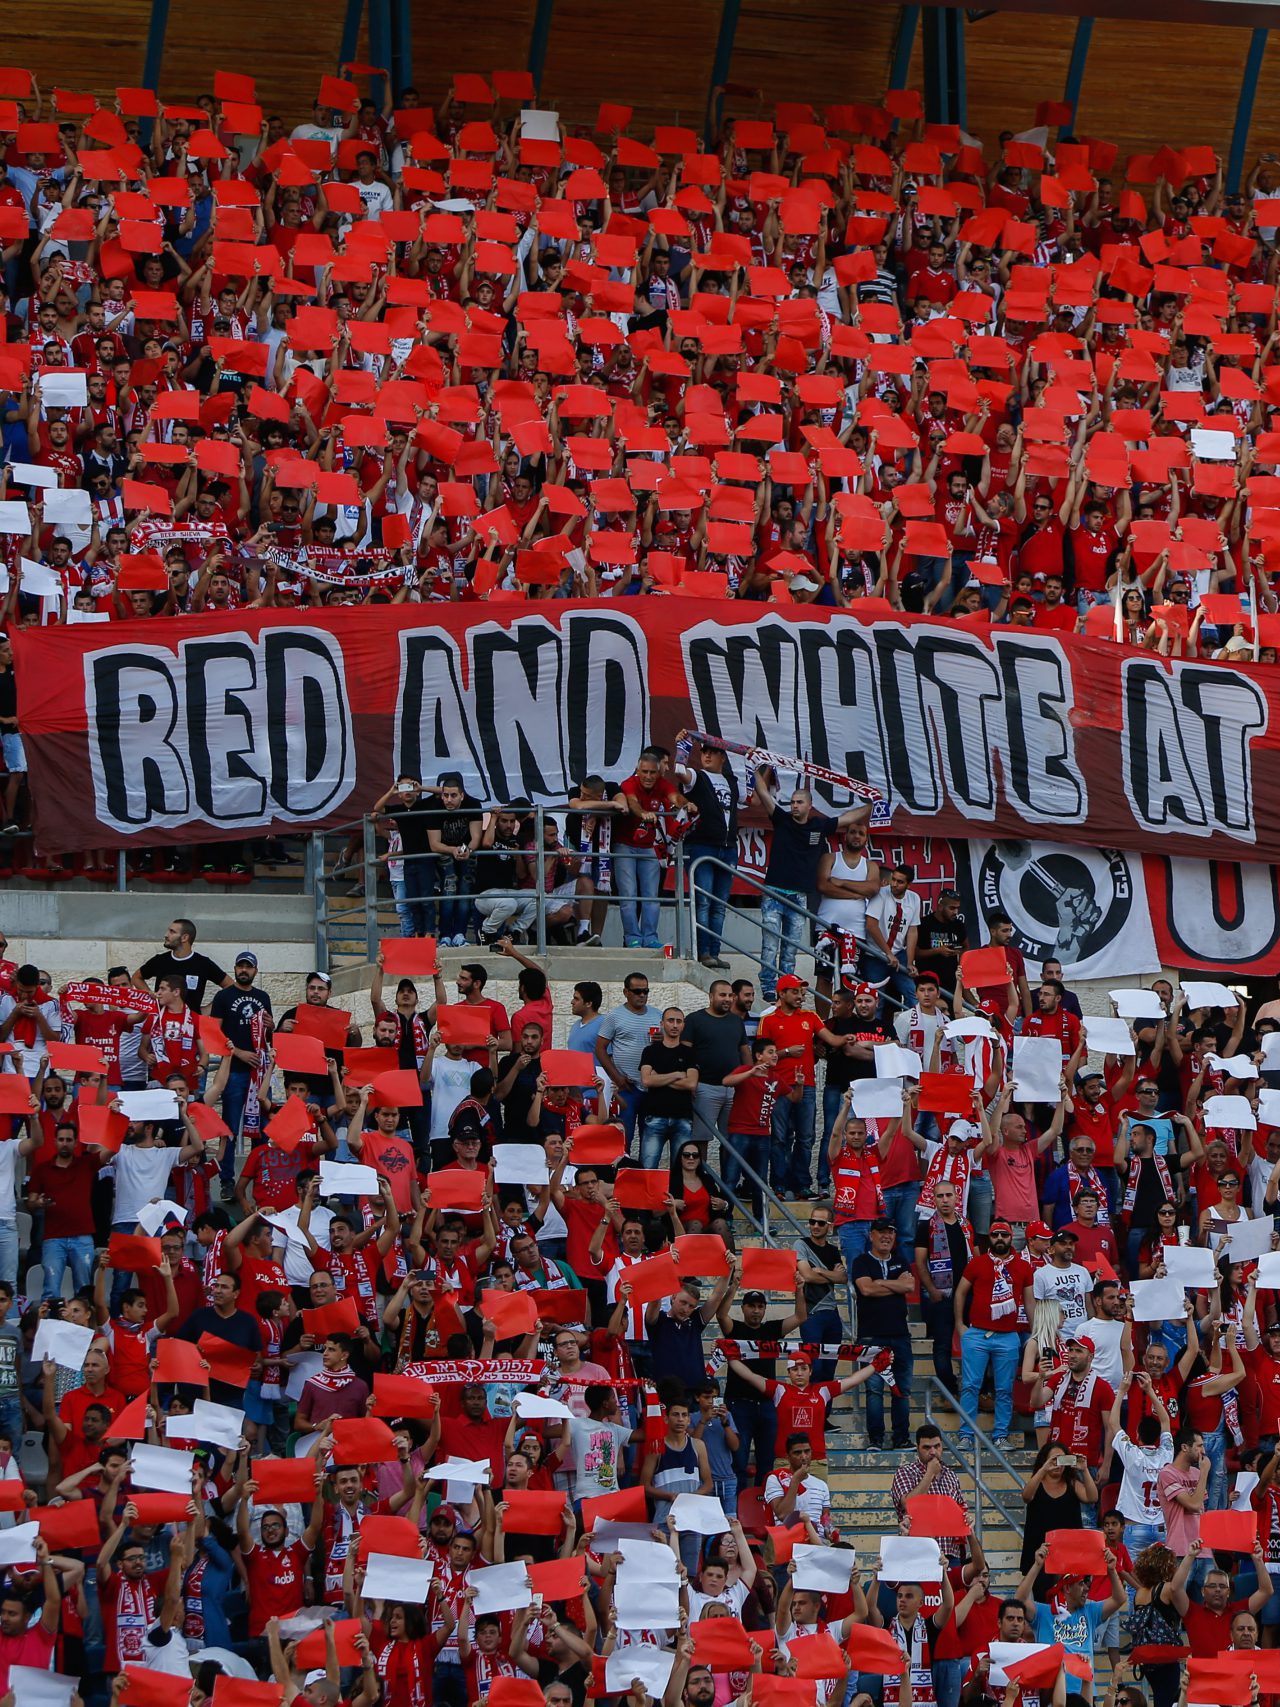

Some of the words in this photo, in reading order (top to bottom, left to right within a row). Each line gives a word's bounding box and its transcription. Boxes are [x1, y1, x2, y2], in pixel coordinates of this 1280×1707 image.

[84, 626, 355, 833] RED
[395, 608, 652, 804] AND
[680, 613, 1089, 823] WHITE
[1121, 657, 1268, 844] AT
[1055, 1275, 1080, 1286] JUST
[431, 1360, 458, 1373] באר
[487, 1359, 528, 1373] הפועל
[484, 1373, 498, 1381] לא
[501, 1373, 532, 1381] לעולם
